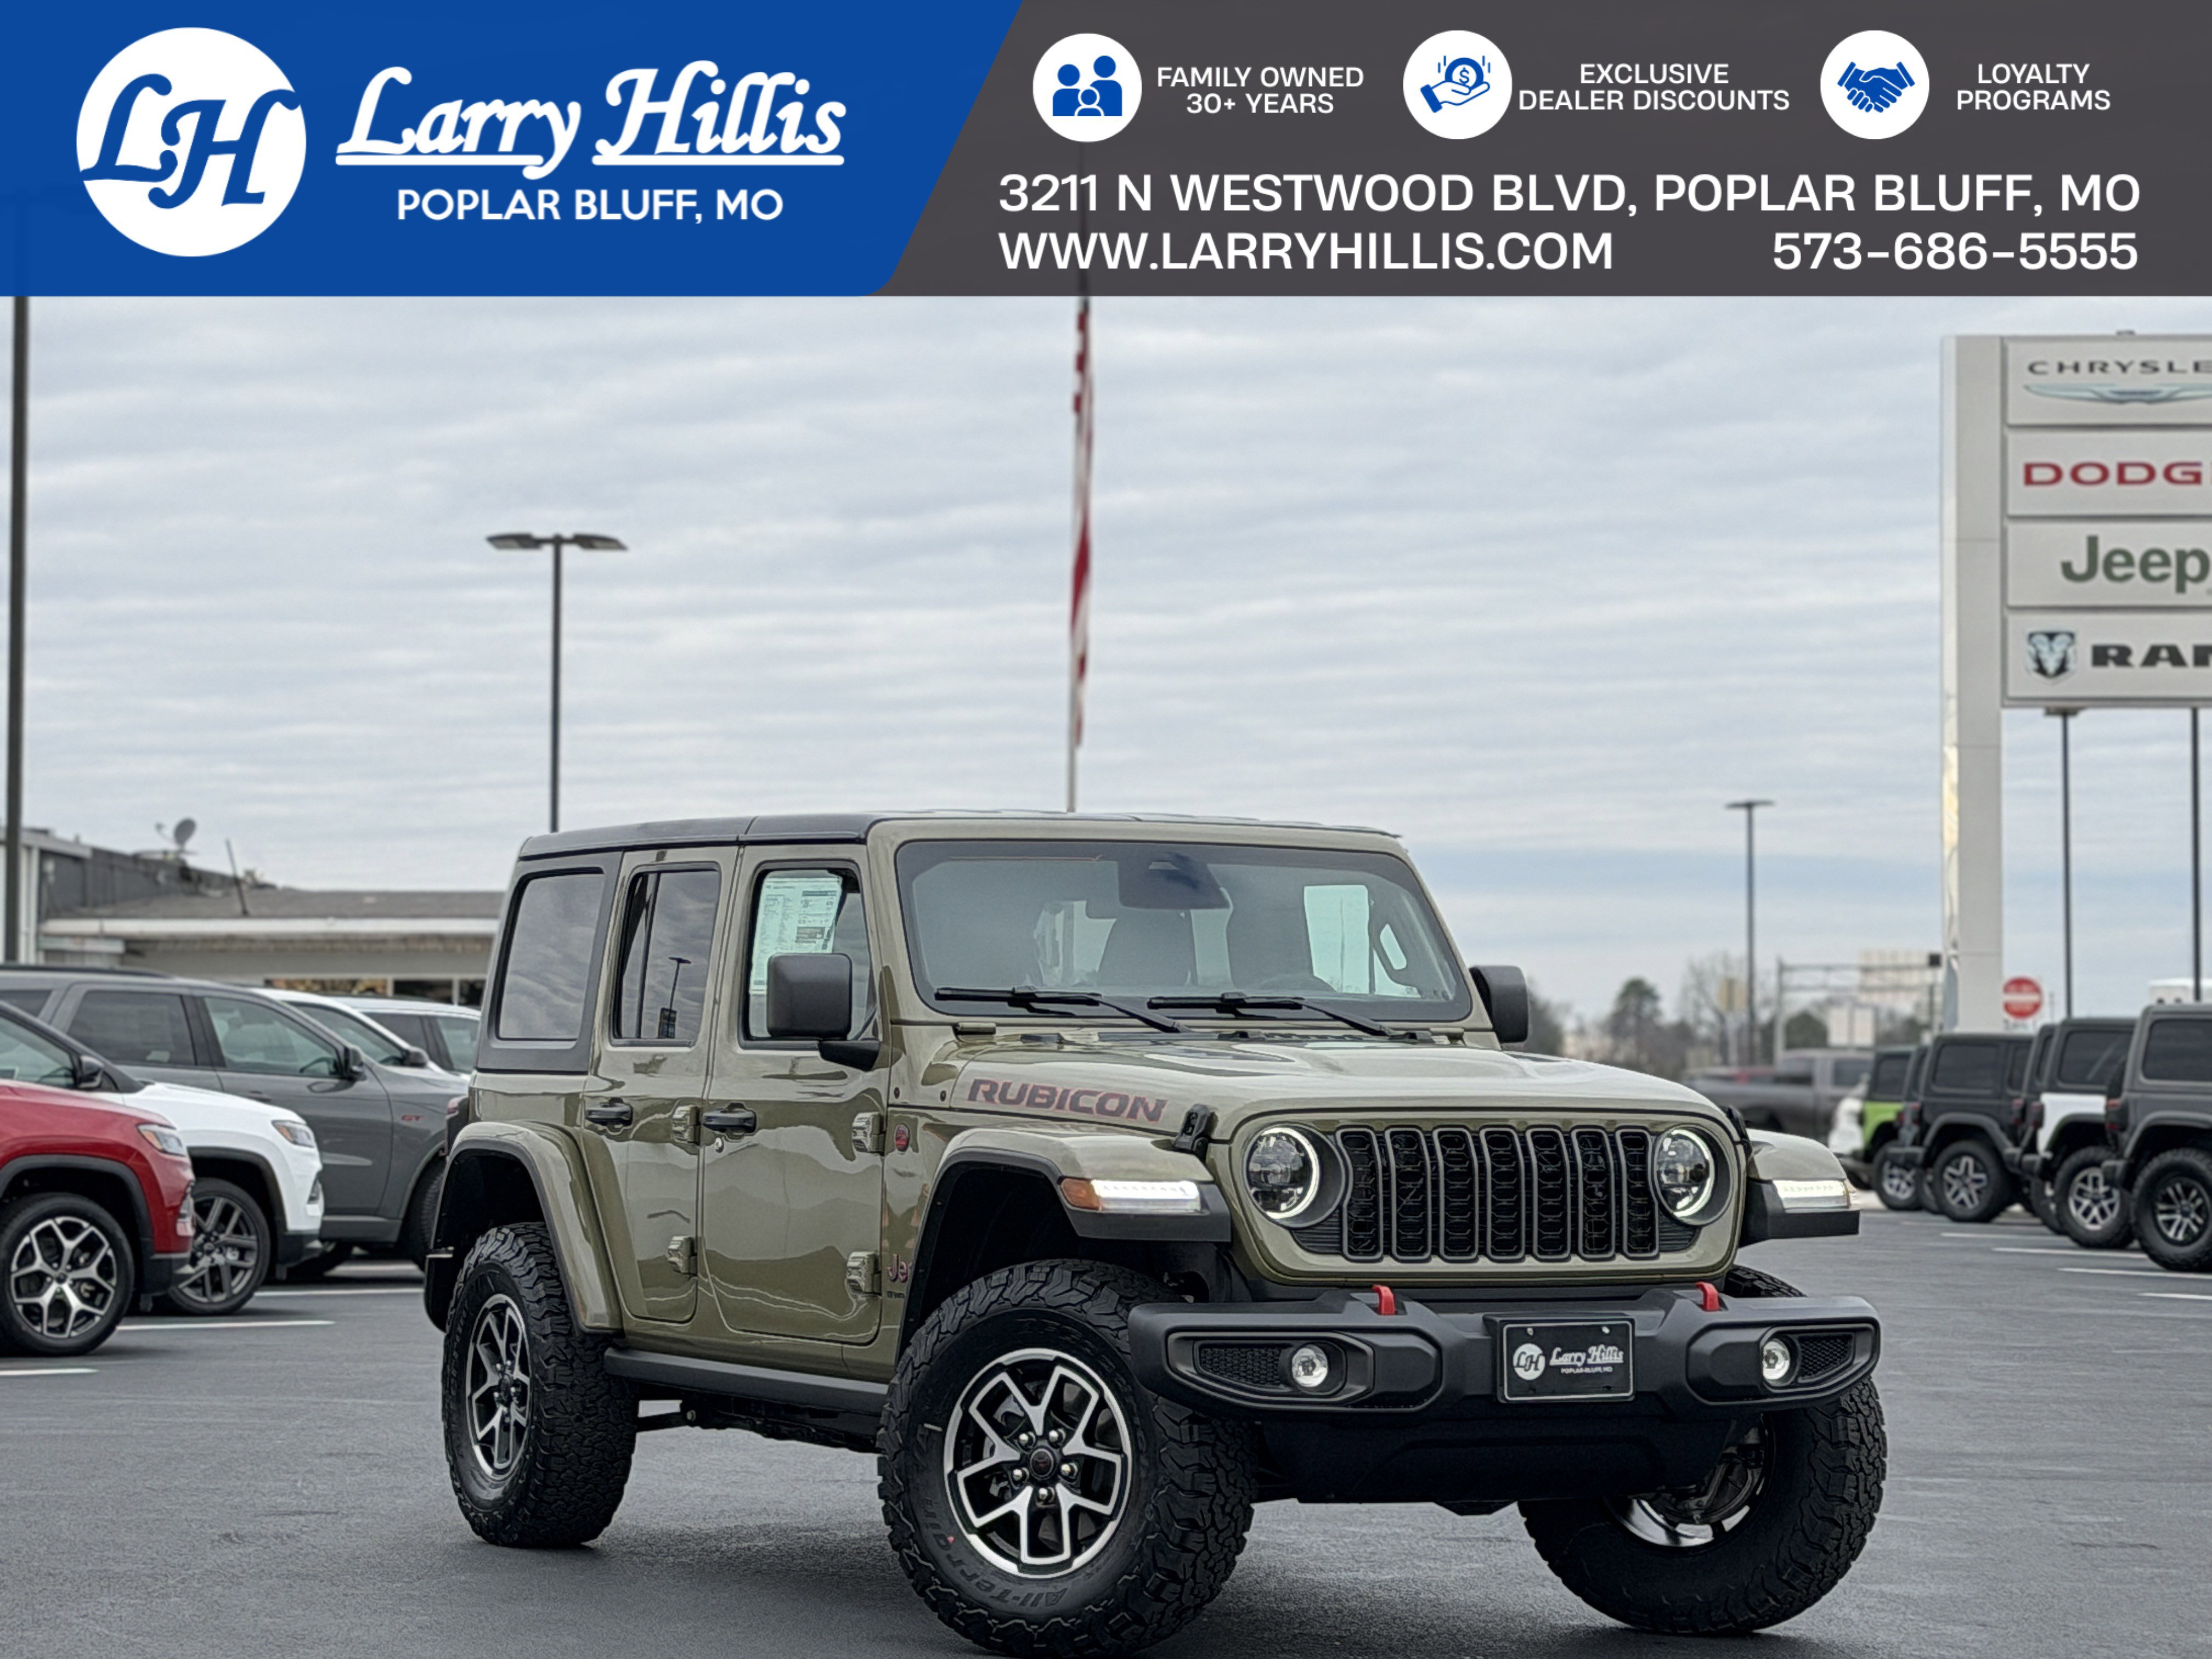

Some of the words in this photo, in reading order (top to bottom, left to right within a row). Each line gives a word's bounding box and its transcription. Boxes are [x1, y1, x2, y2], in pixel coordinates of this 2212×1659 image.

[2024, 462, 2212, 486] DODG
[2061, 535, 2210, 594] Jeep
[967, 1078, 1169, 1122] RUBICON
[887, 1252, 911, 1283] Je
[1549, 1346, 1587, 1367] Larry
[1587, 1344, 1624, 1364] Hillis
